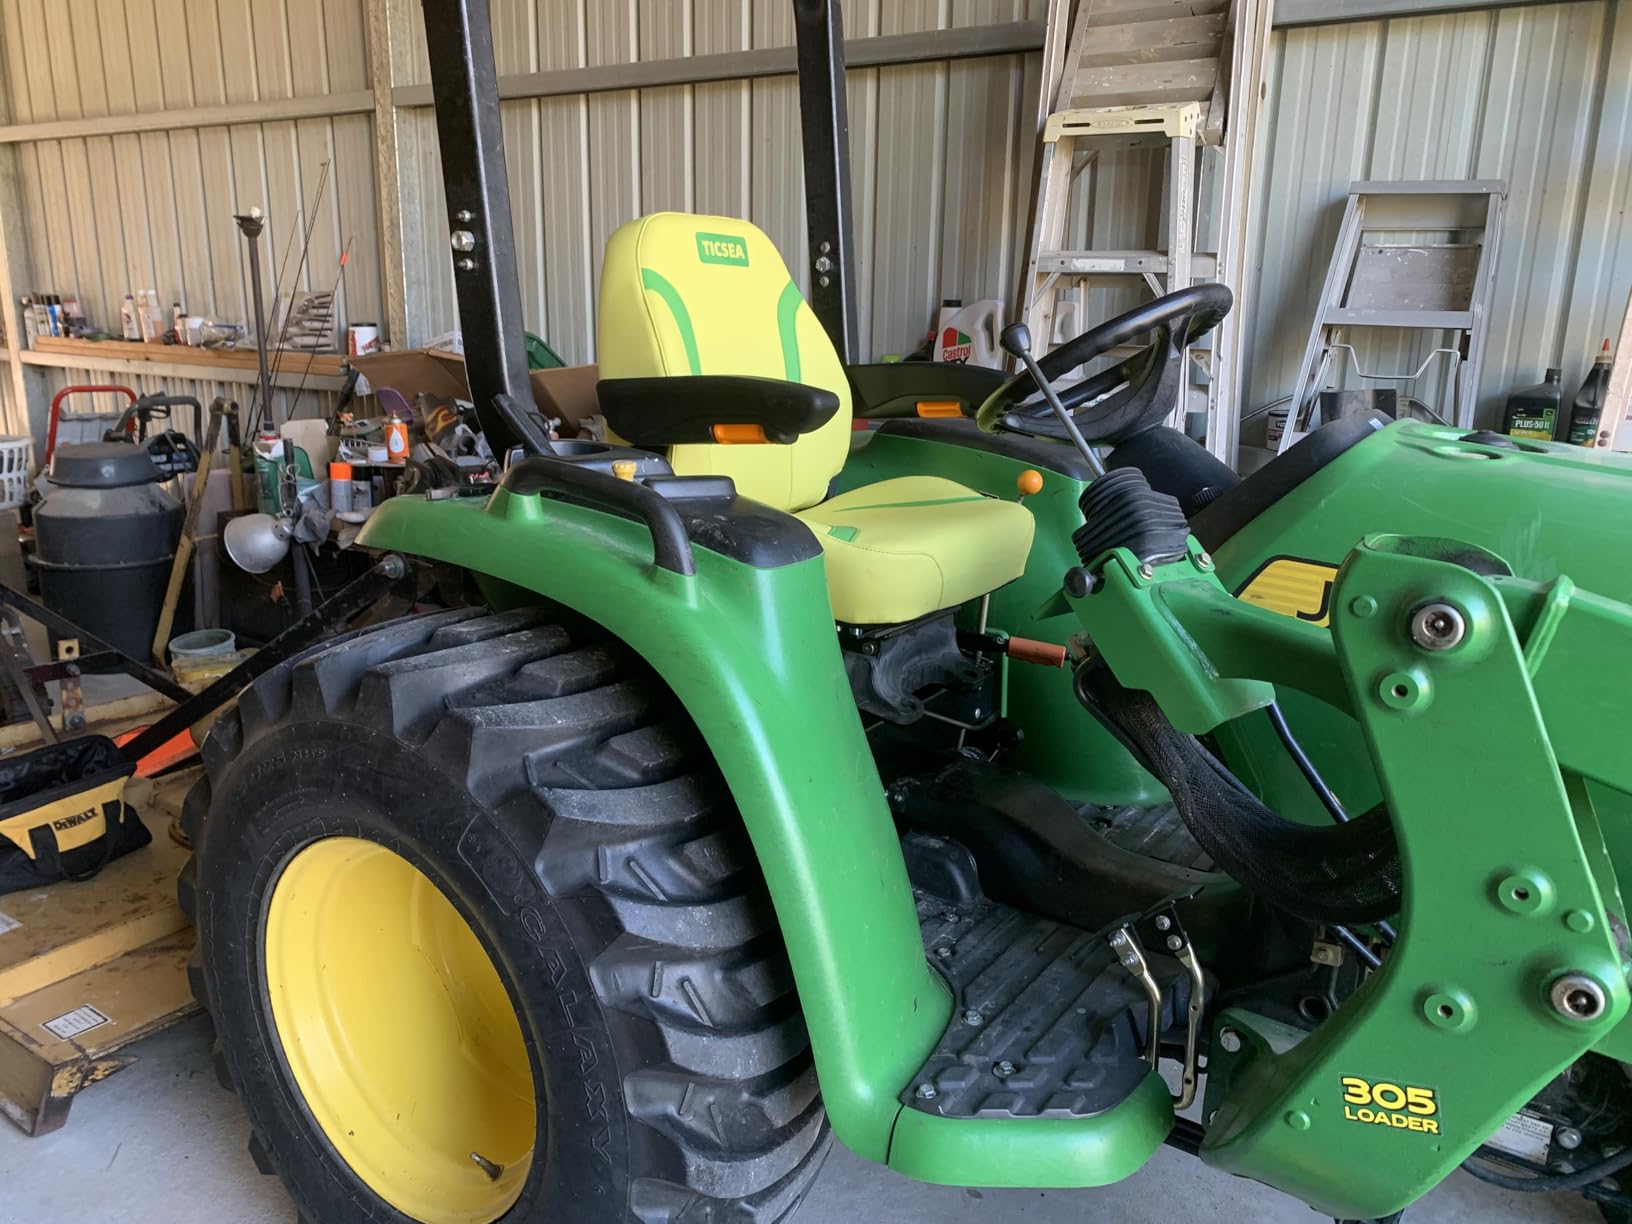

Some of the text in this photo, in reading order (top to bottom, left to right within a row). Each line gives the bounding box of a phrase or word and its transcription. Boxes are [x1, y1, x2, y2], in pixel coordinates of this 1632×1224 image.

[701, 239, 746, 260] TICSEA
[943, 344, 971, 361] Castrol
[1514, 419, 1544, 430] PLUS-50
[519, 905, 613, 1167] GALAXY
[1341, 1076, 1438, 1116] 305
[1344, 1105, 1440, 1135] LOADER
